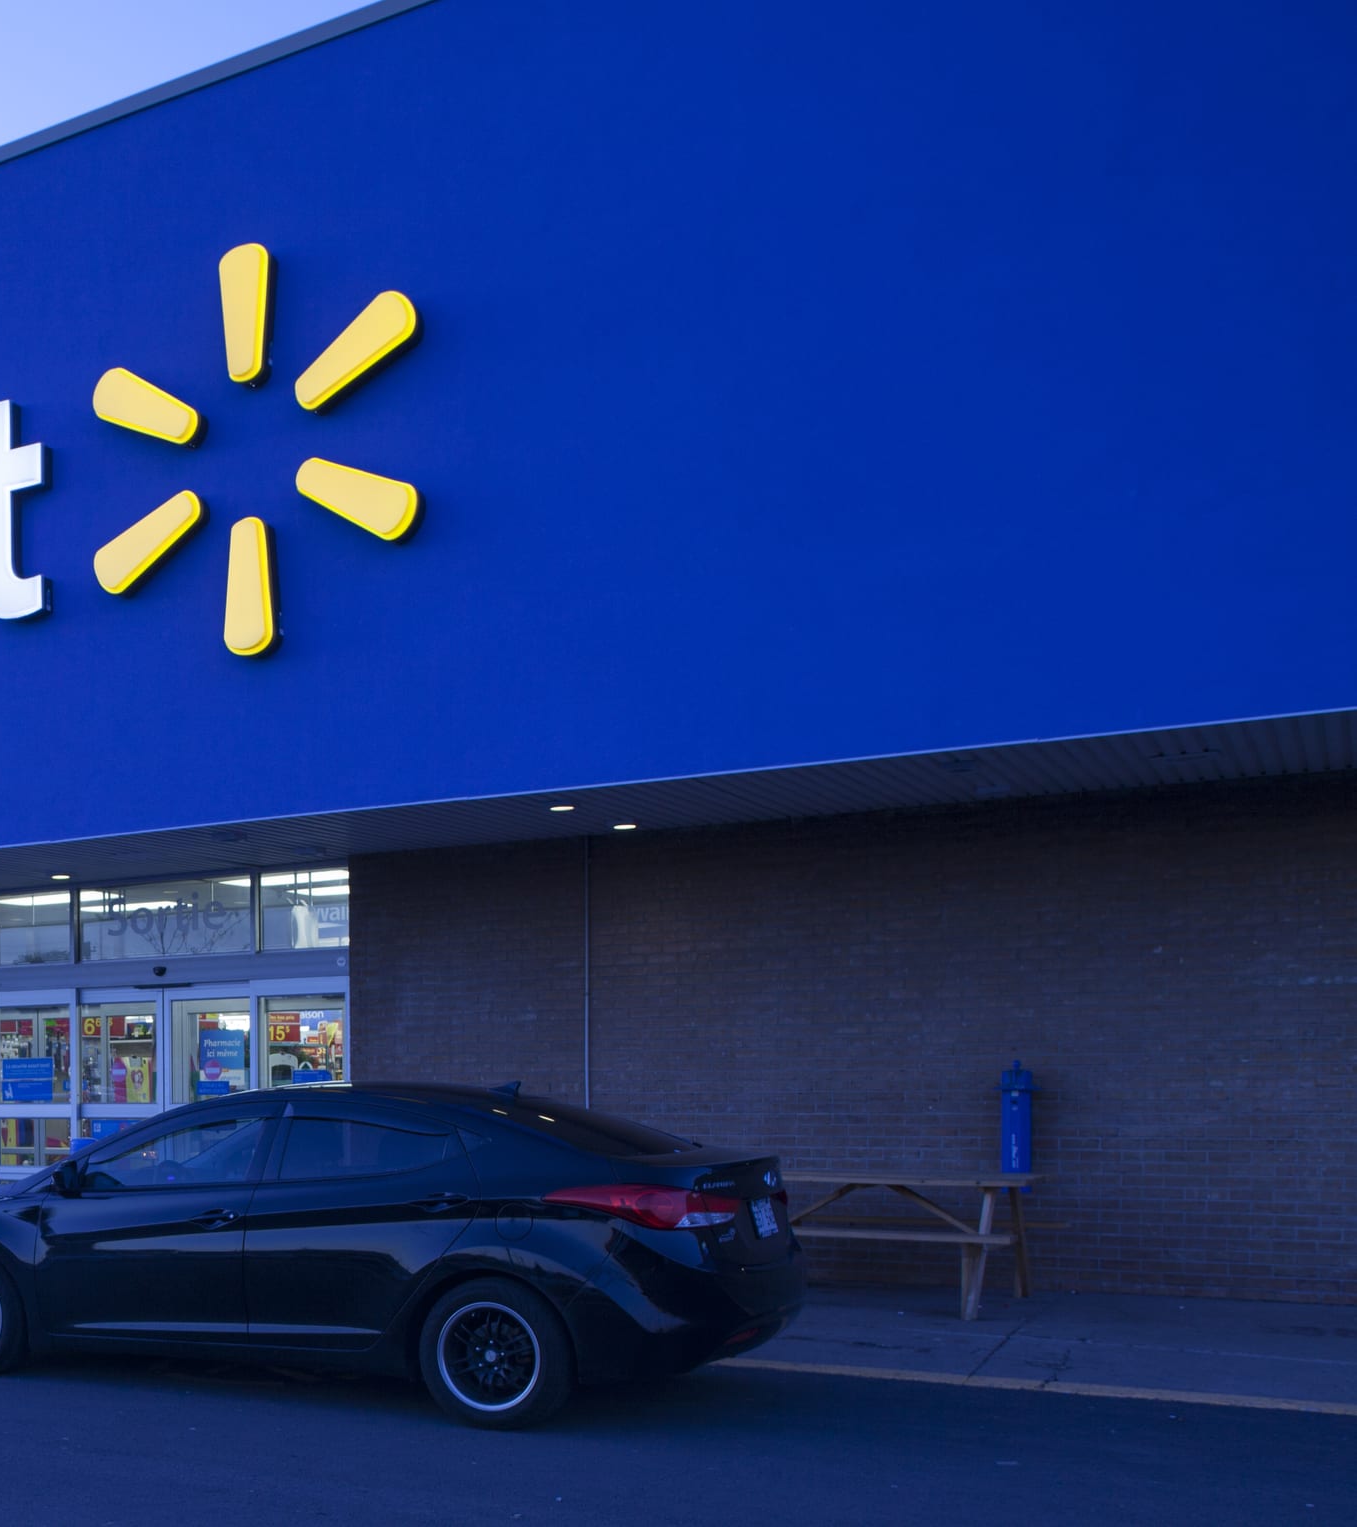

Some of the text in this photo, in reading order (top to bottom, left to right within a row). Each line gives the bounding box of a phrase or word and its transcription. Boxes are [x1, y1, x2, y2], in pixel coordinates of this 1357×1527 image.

[108, 891, 227, 937] Sortie
[203, 1038, 241, 1047] Pharmacie
[206, 1048, 238, 1057] ici même
